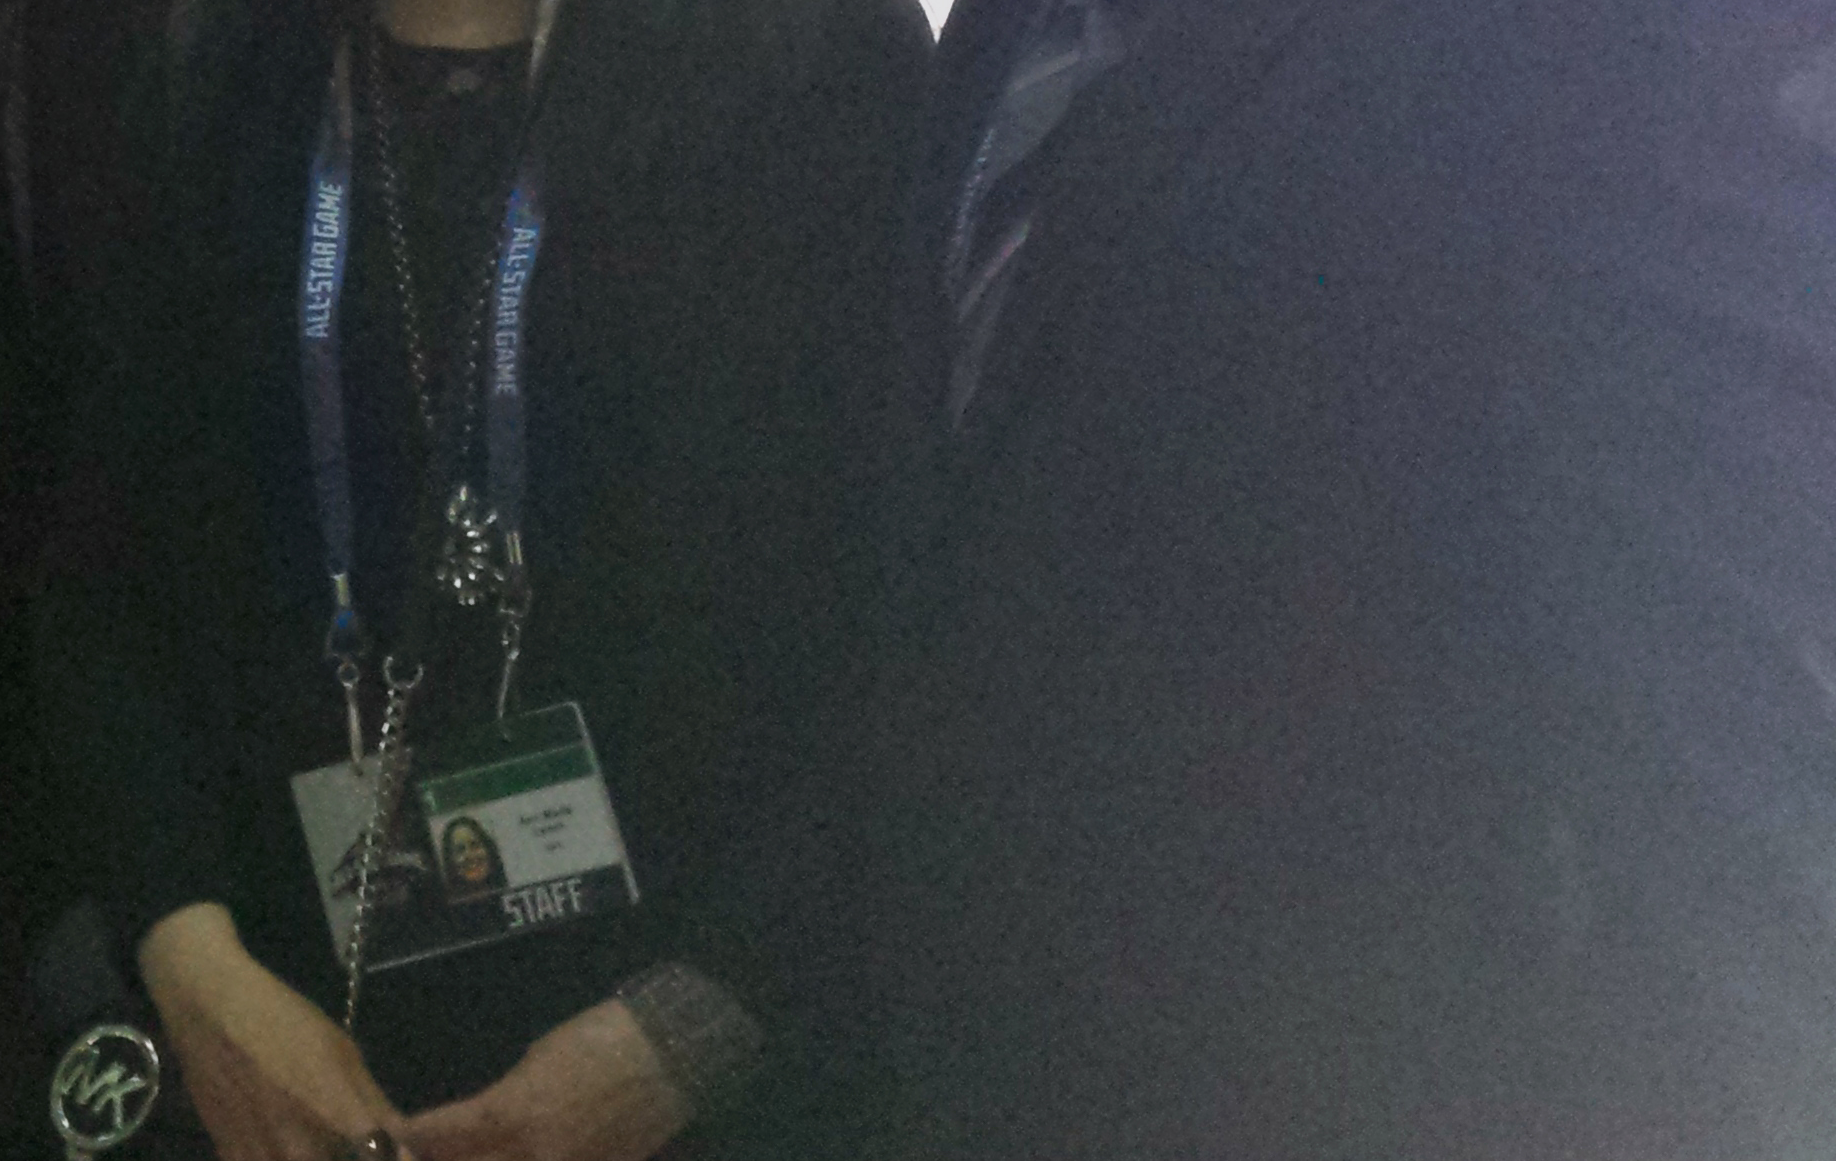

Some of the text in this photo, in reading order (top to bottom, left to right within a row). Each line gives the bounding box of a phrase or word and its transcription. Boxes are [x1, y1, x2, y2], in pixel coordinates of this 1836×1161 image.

[312, 180, 344, 239] GAME
[494, 330, 518, 396] GAME
[502, 879, 583, 928] STAFF
